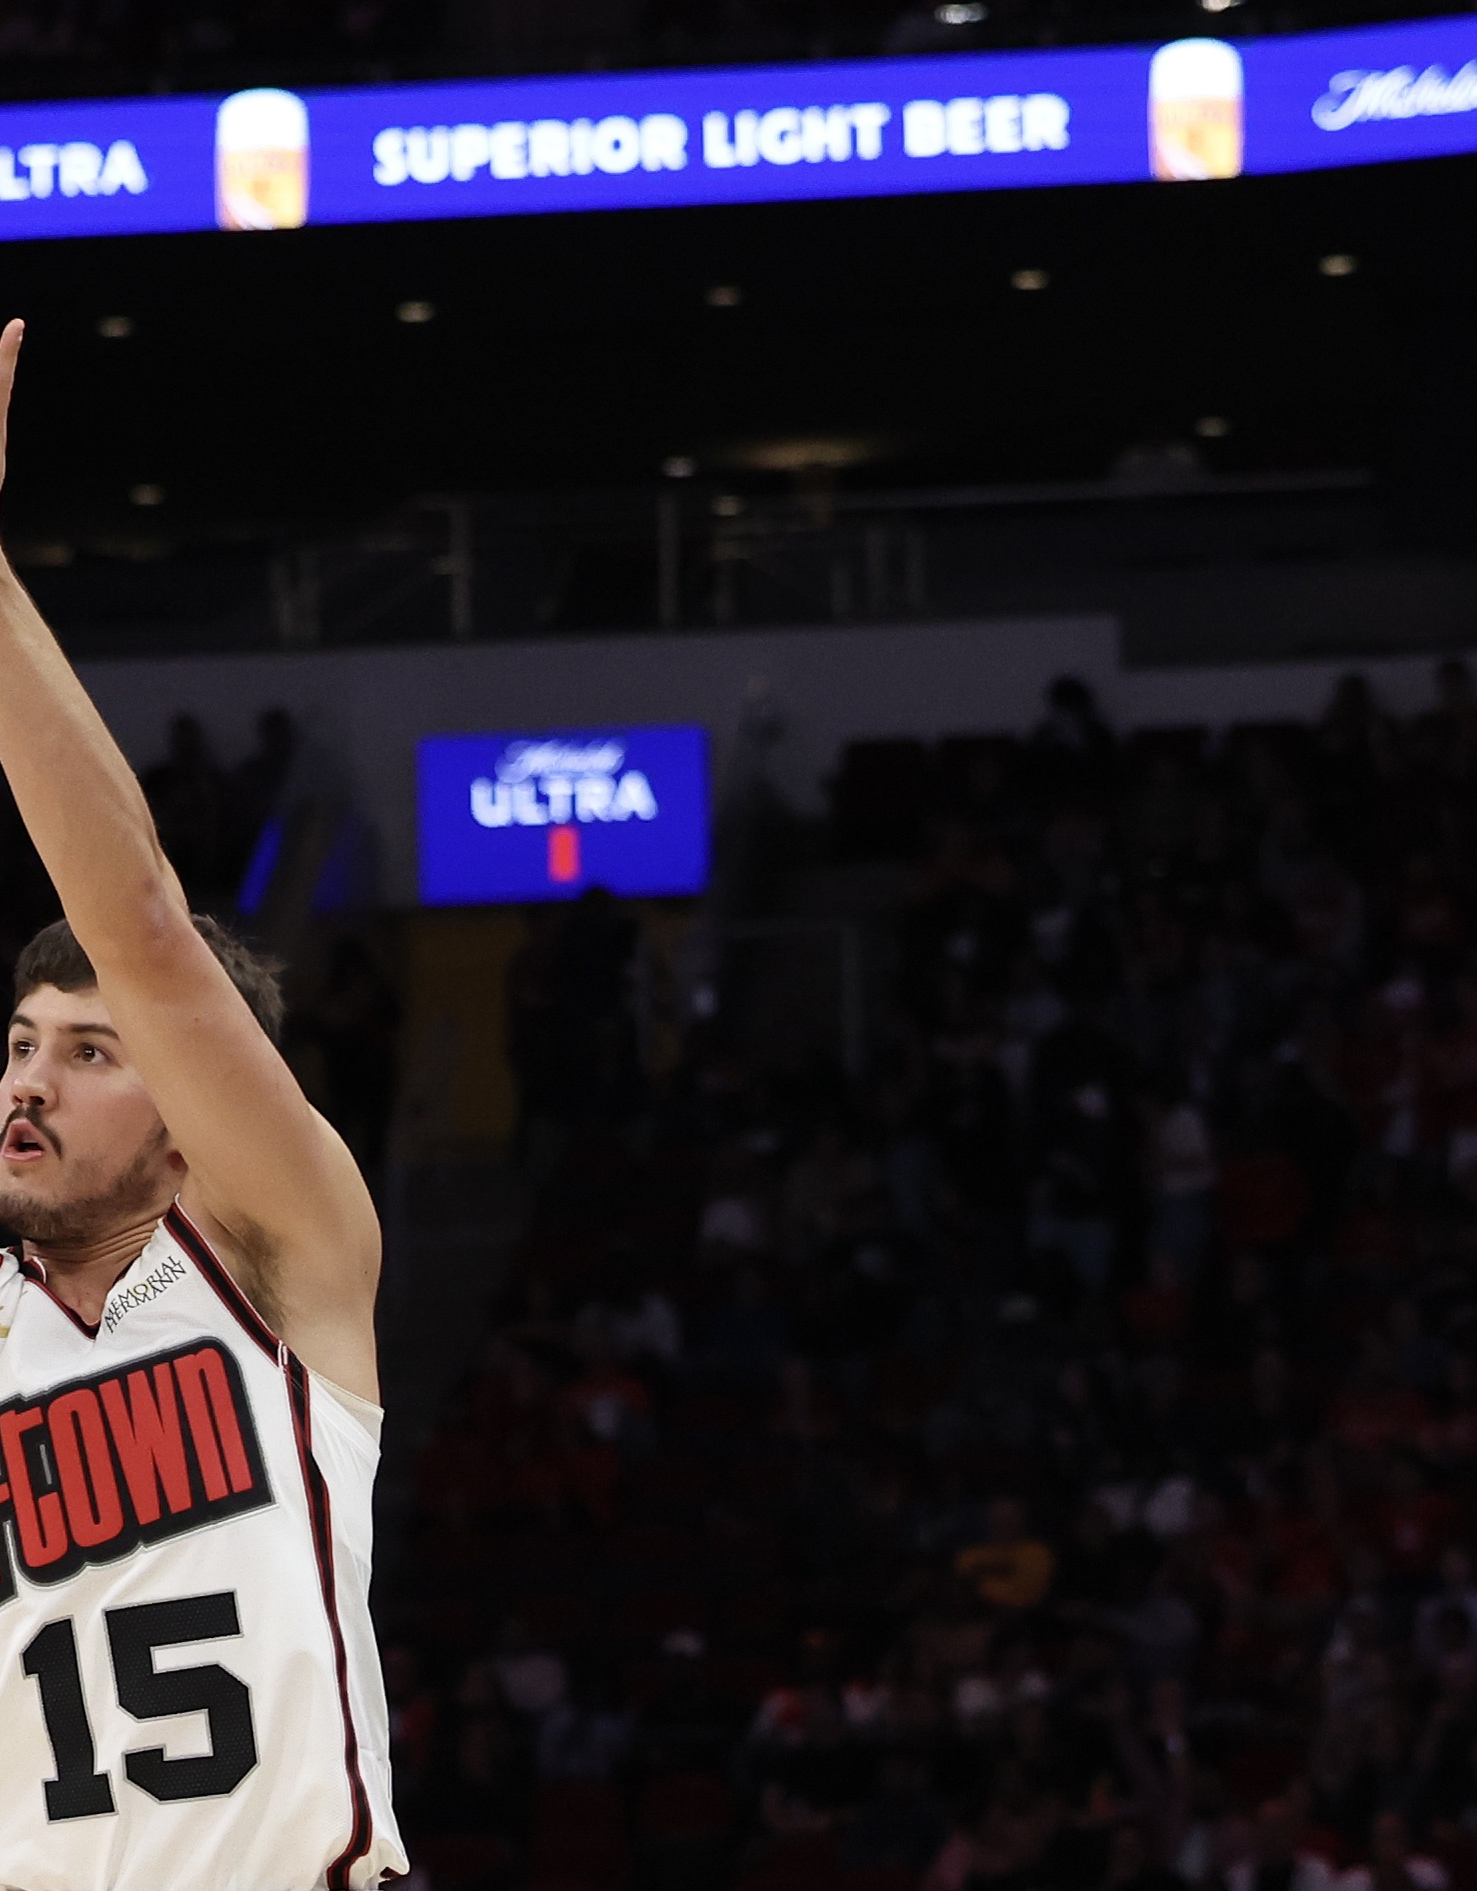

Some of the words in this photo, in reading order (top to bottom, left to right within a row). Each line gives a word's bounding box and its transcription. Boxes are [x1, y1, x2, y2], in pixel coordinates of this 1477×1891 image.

[372, 112, 689, 186] SUPERIOR
[702, 101, 892, 168] LIGHT
[902, 92, 1071, 158] BEER
[469, 768, 659, 828] ULTRA
[104, 1254, 182, 1322] MEMORIAL
[104, 1262, 187, 1334] HERMANN
[21, 1589, 261, 1824] 15
